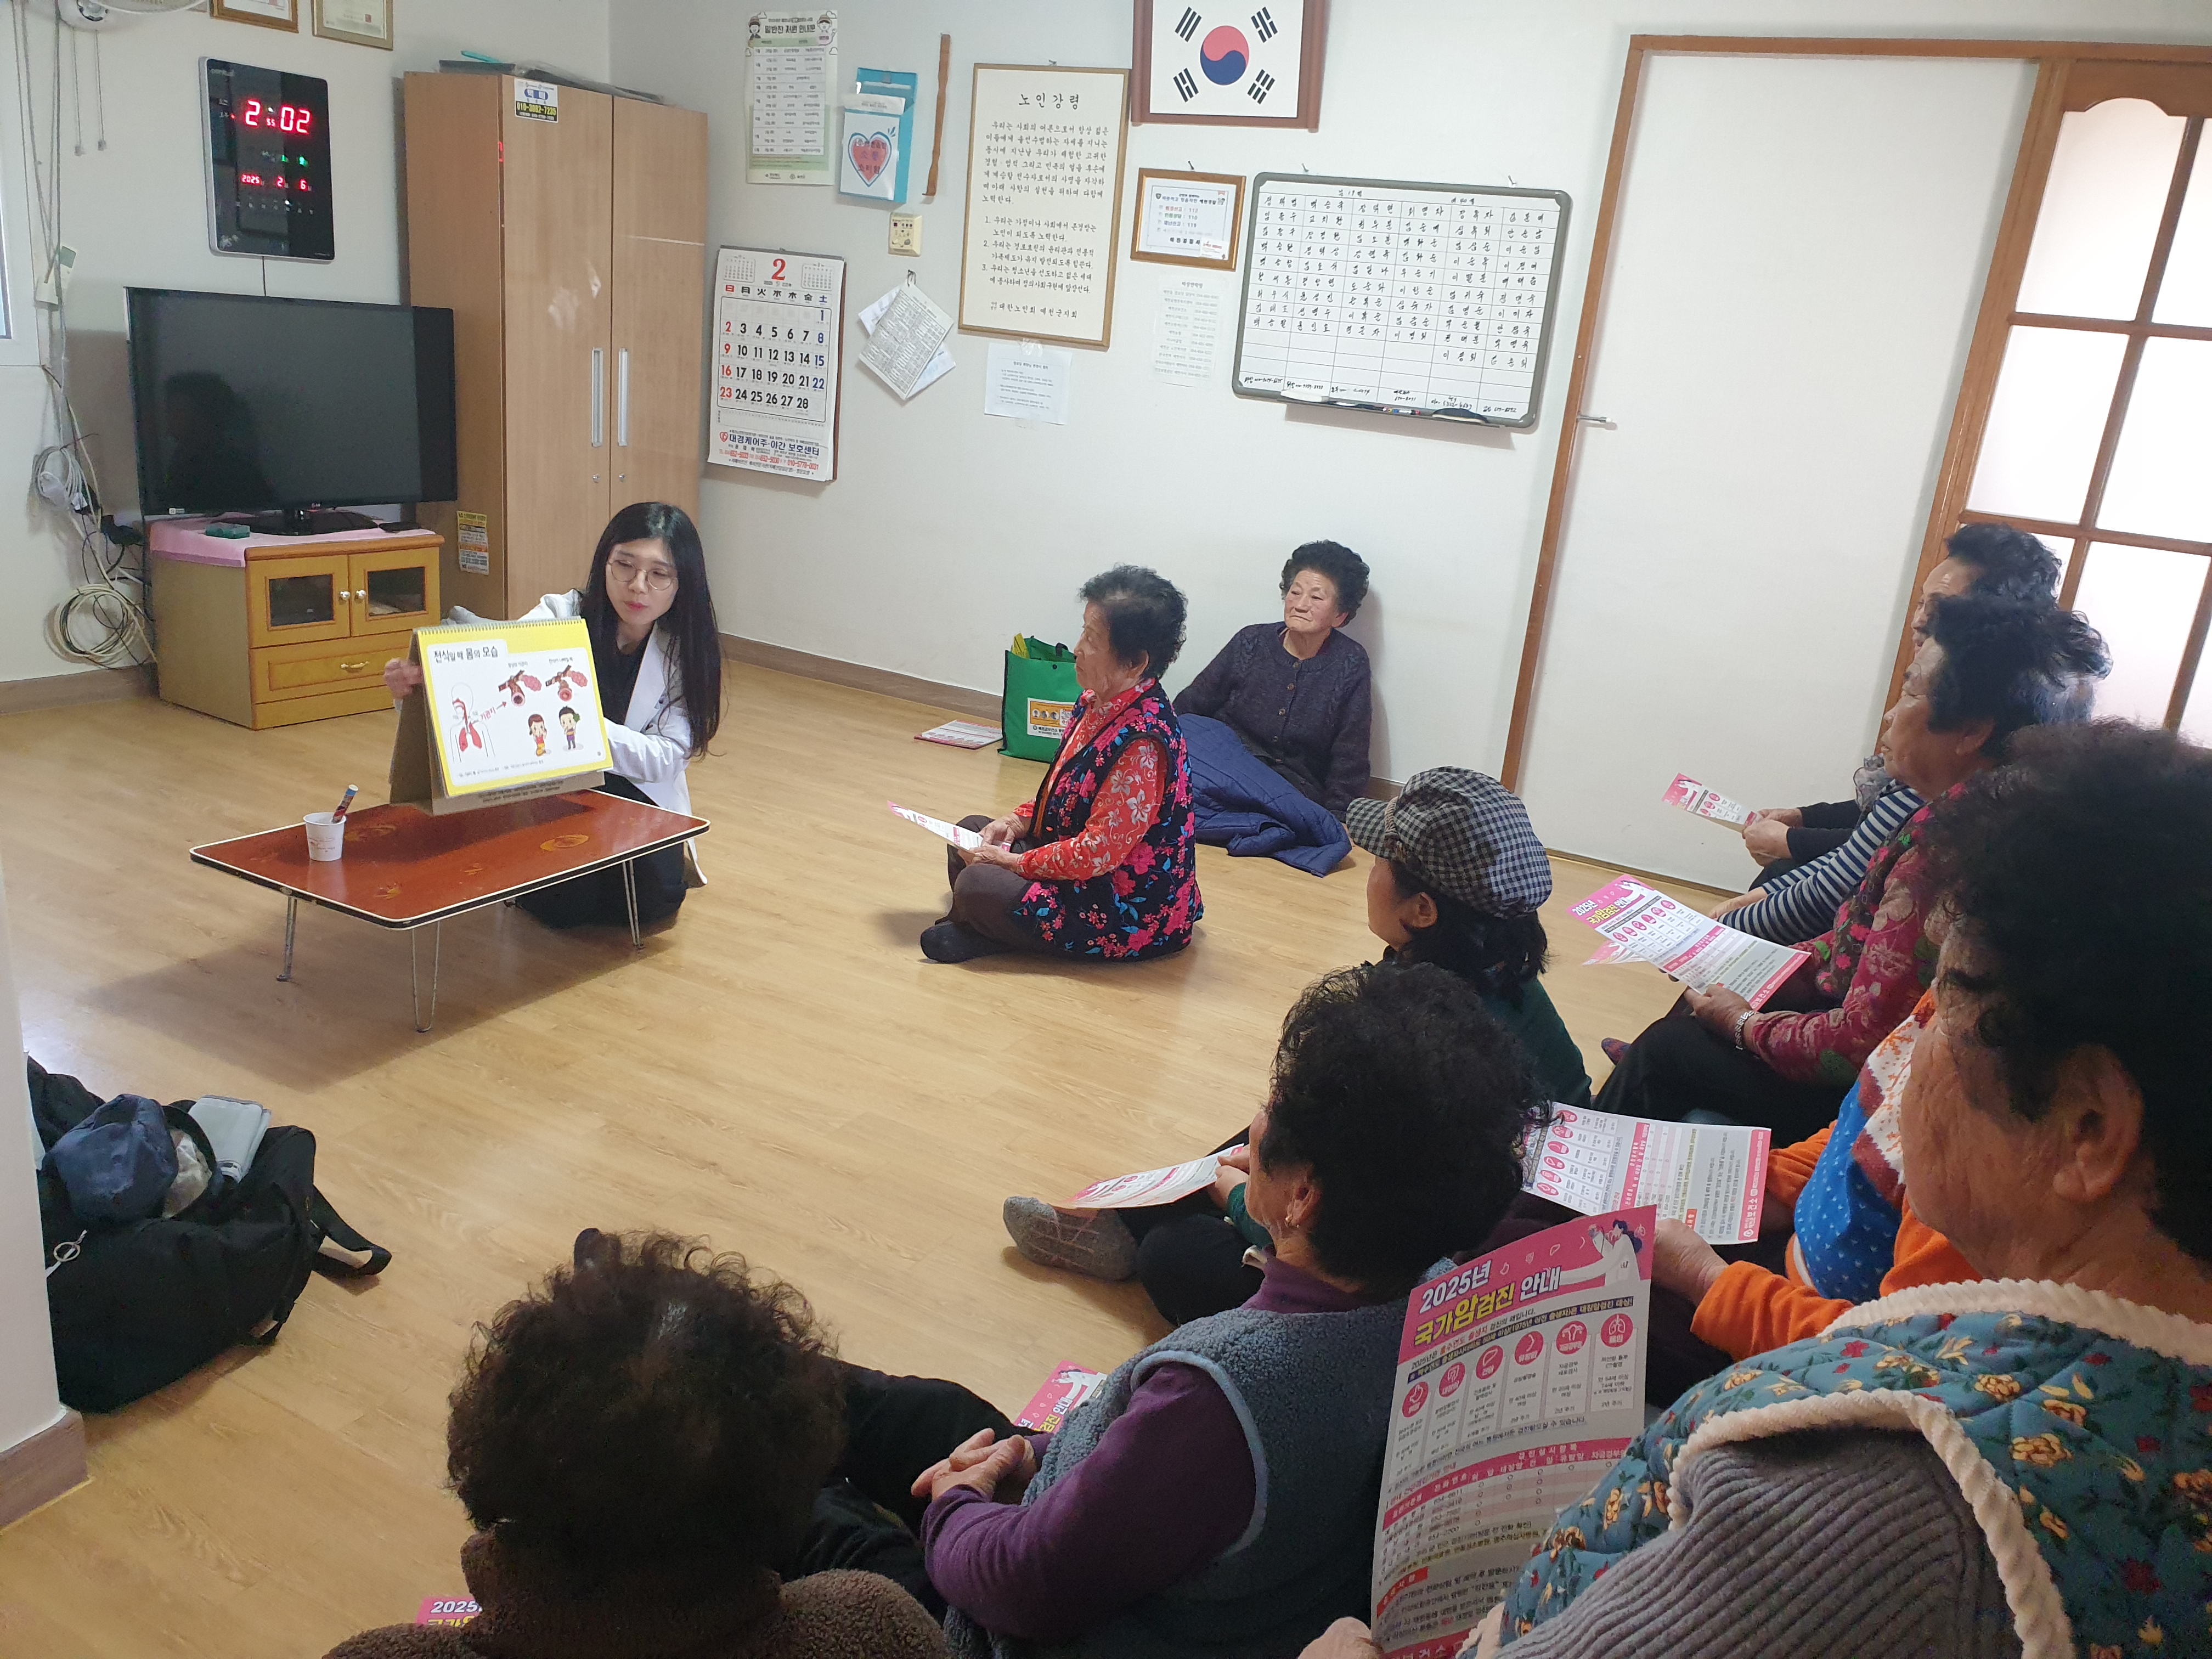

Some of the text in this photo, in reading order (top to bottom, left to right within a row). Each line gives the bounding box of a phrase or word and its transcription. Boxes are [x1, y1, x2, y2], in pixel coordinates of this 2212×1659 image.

[1019, 93, 1079, 110] 노인강령
[992, 121, 1013, 131] 우리는
[1036, 149, 1056, 157] 우리가
[242, 173, 306, 190] 2025 2 6
[994, 216, 1013, 225] 우리는
[993, 229, 1012, 237] 노인이
[992, 240, 1011, 250] 우리는
[771, 259, 786, 280] 2
[991, 264, 1009, 273] 우리는
[821, 310, 823, 321] 1
[726, 321, 823, 343] 2 3 4 5 6 7 8
[725, 343, 824, 366] 9 10 11 12 13 14 15
[722, 365, 824, 389] 16 17 18 19 20 21 22
[720, 387, 808, 409] 23 24 25 26 27 28
[788, 443, 820, 456] 보호센터
[482, 645, 498, 658] 모습
[1419, 1260, 1492, 1314] 2025년
[1414, 1266, 1561, 1346] 국가암검진 안내
